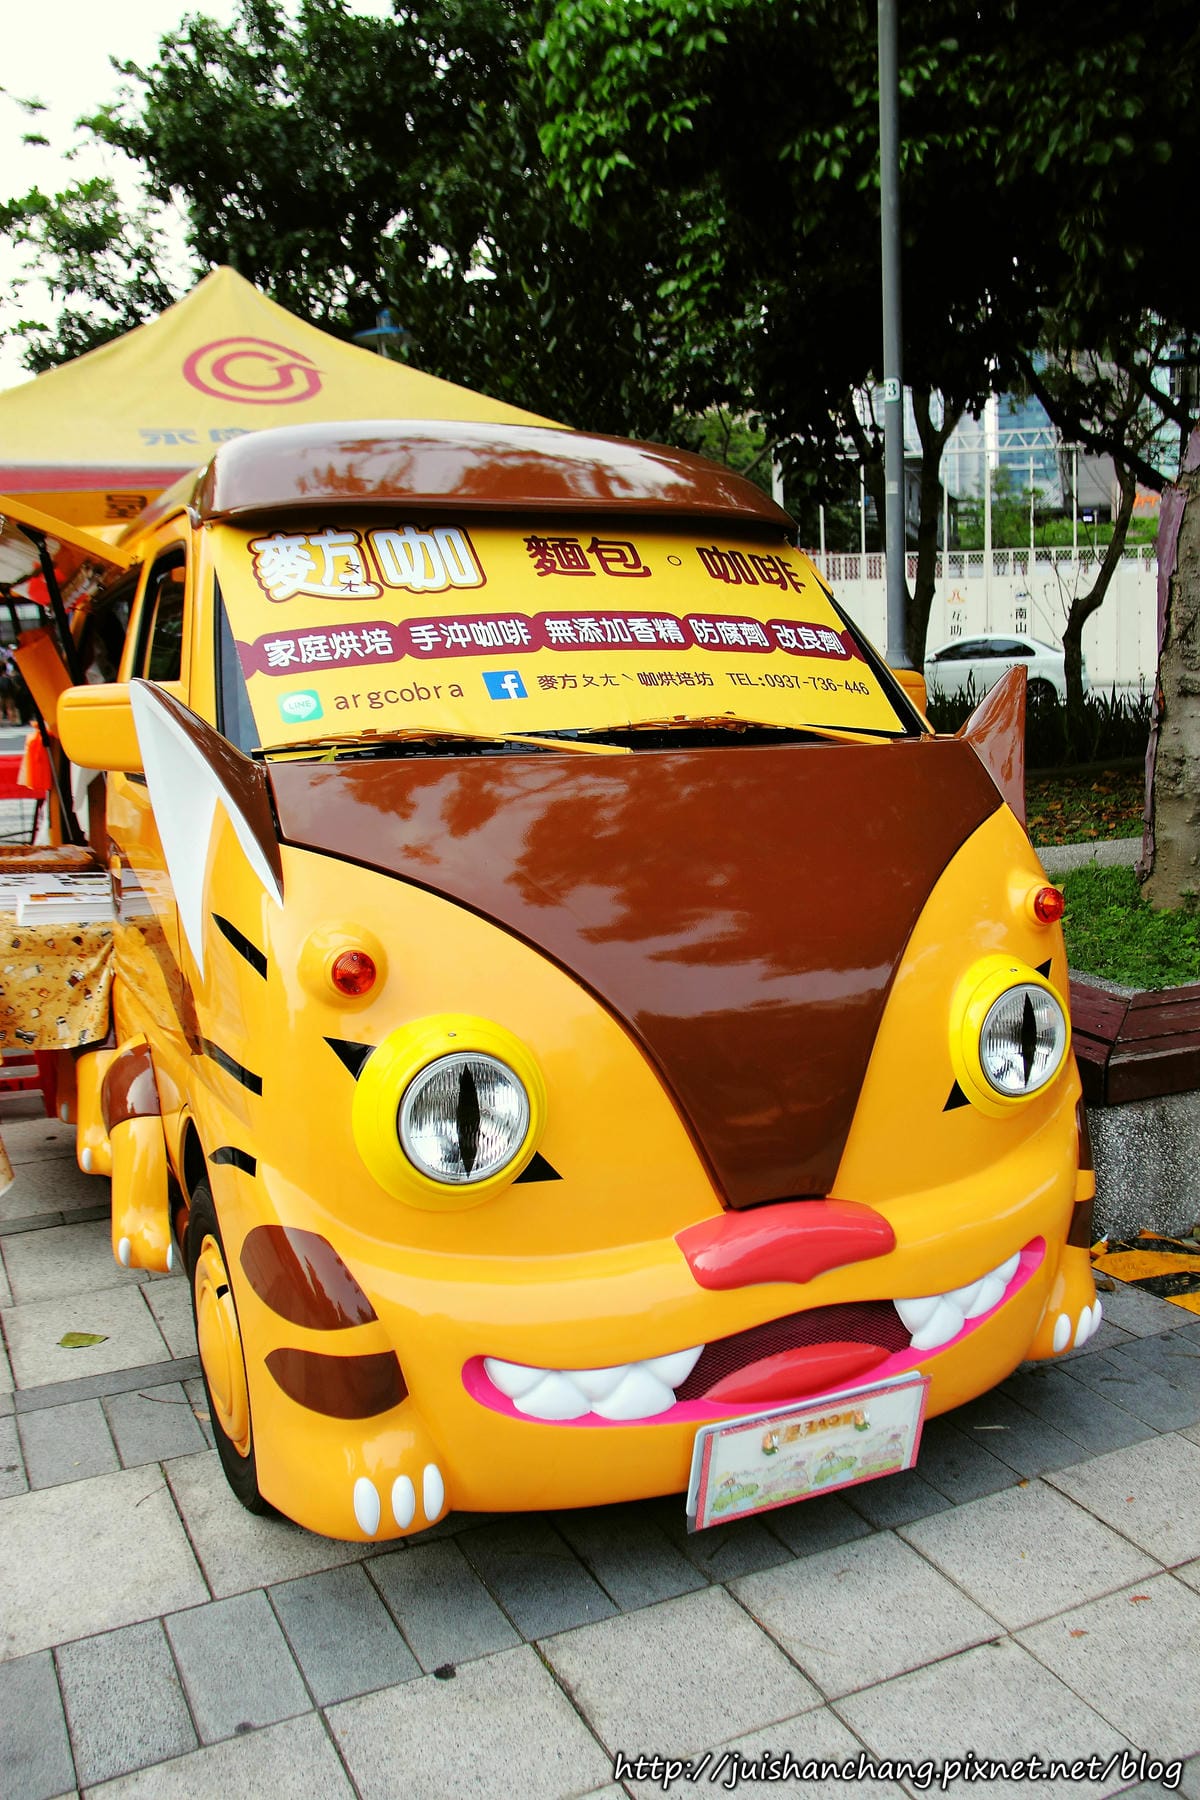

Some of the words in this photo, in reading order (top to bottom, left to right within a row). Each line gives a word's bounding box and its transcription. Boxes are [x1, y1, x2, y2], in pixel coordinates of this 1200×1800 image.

[263, 628, 394, 668] 家庭烘培
[409, 618, 532, 652] 手沖咖啡
[544, 616, 686, 645] 無添加香精
[688, 620, 771, 648] 防腐劑
[775, 624, 848, 655] 改良劑
[288, 700, 312, 711] LINE
[333, 682, 464, 711] argcobra
